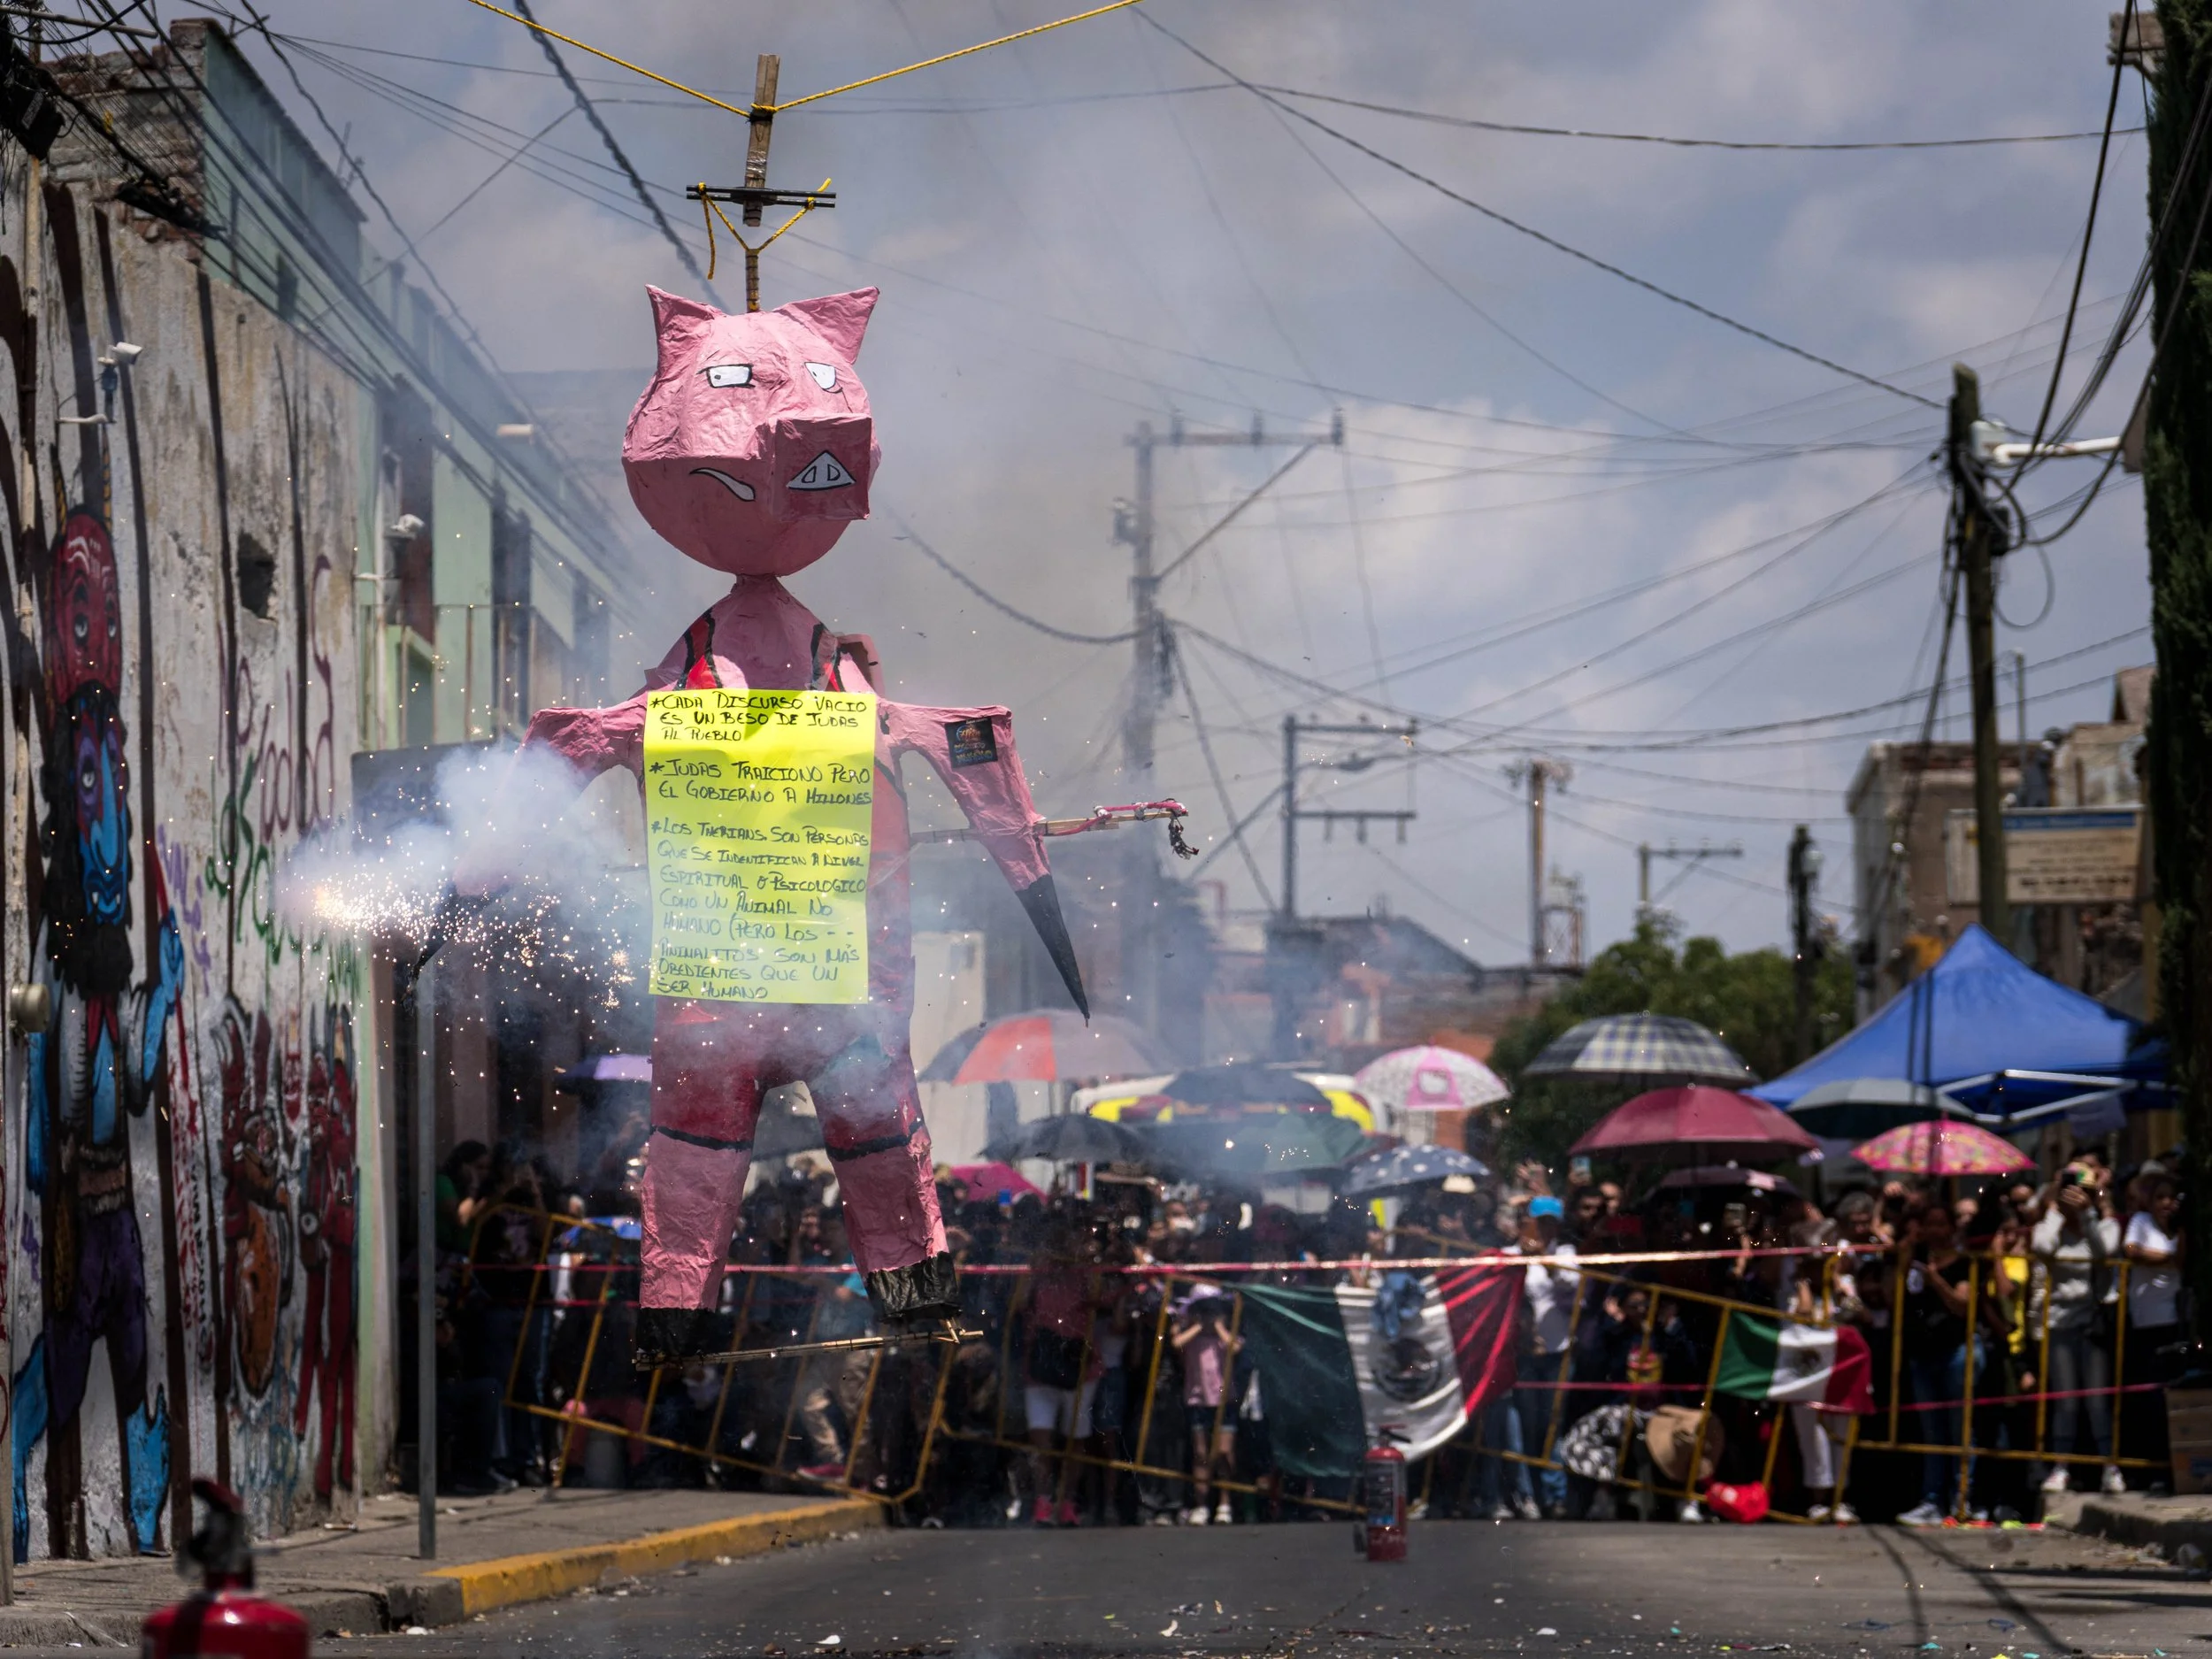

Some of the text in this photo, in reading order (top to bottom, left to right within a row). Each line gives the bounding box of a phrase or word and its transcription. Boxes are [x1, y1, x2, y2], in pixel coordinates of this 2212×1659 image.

[712, 690, 803, 710] DISCURSO
[814, 695, 867, 712] VACIO
[659, 710, 858, 728] ES UN BESO DE JUDAS
[661, 726, 741, 741] AL PUEBLO
[662, 758, 871, 785] JUDAS TRAICIONO PERO
[658, 780, 680, 798] EL
[686, 779, 775, 803] GOBIERNO
[782, 786, 797, 804] A
[663, 816, 693, 835] LOS
[770, 826, 800, 843] SON
[802, 825, 870, 846] PERSONAS
[657, 839, 687, 859] QUE
[690, 846, 712, 862] SE
[717, 849, 807, 866] INDENTIFICAN
[810, 852, 820, 867] A
[659, 864, 866, 894] ESPIRITUAL O PSICOLOGICO
[658, 887, 833, 917] COMO UN ANIMAL NO
[663, 910, 722, 936] HUMANO
[784, 922, 819, 941] LOS
[658, 936, 759, 963] ANIMALITOS
[772, 947, 817, 964] SON
[658, 956, 839, 982] OBEDIENTES QUE UN
[657, 976, 769, 999] SER HUMANO
